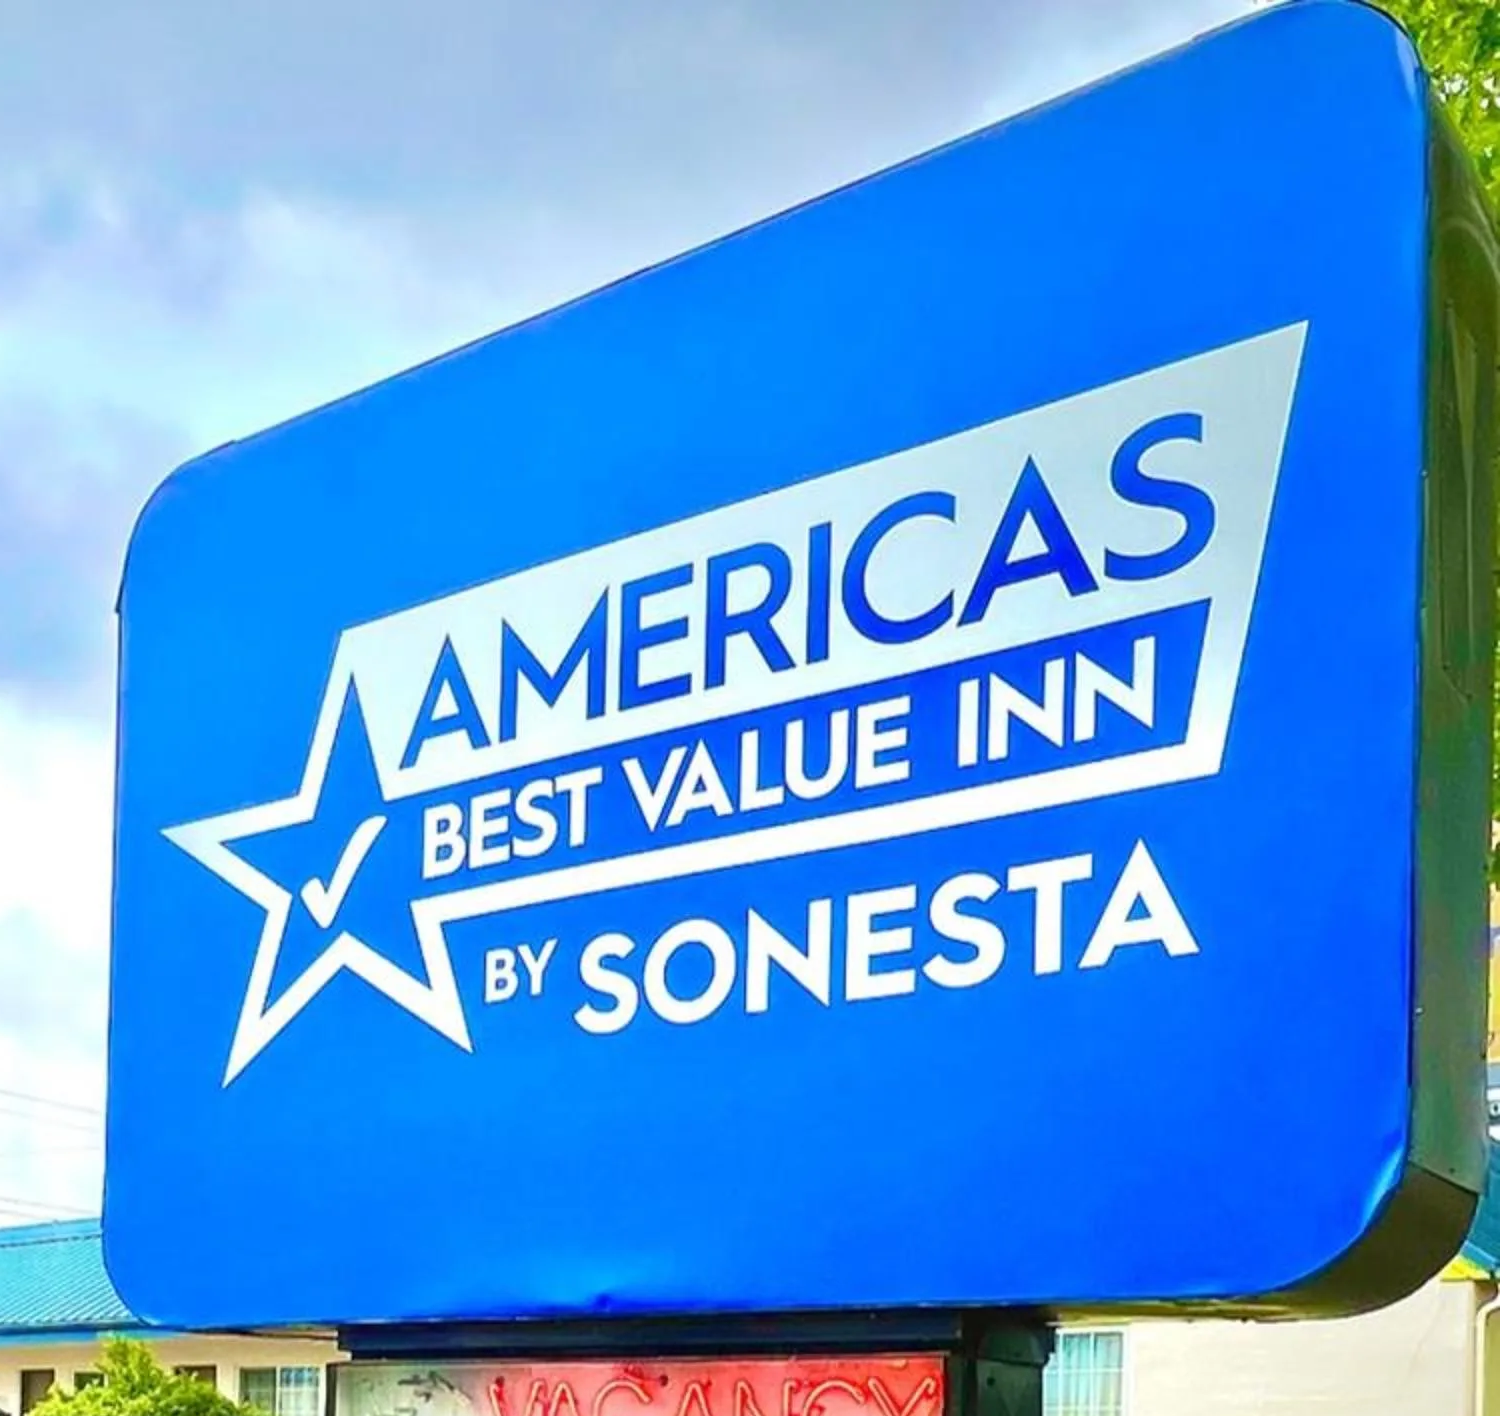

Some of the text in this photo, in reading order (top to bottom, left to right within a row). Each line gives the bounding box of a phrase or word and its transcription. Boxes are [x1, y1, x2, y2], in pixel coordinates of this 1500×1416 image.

[399, 412, 1217, 771] AMERICAS
[421, 636, 1158, 880] BEST VALUE INN
[483, 838, 1200, 1034] BY SONESTA
